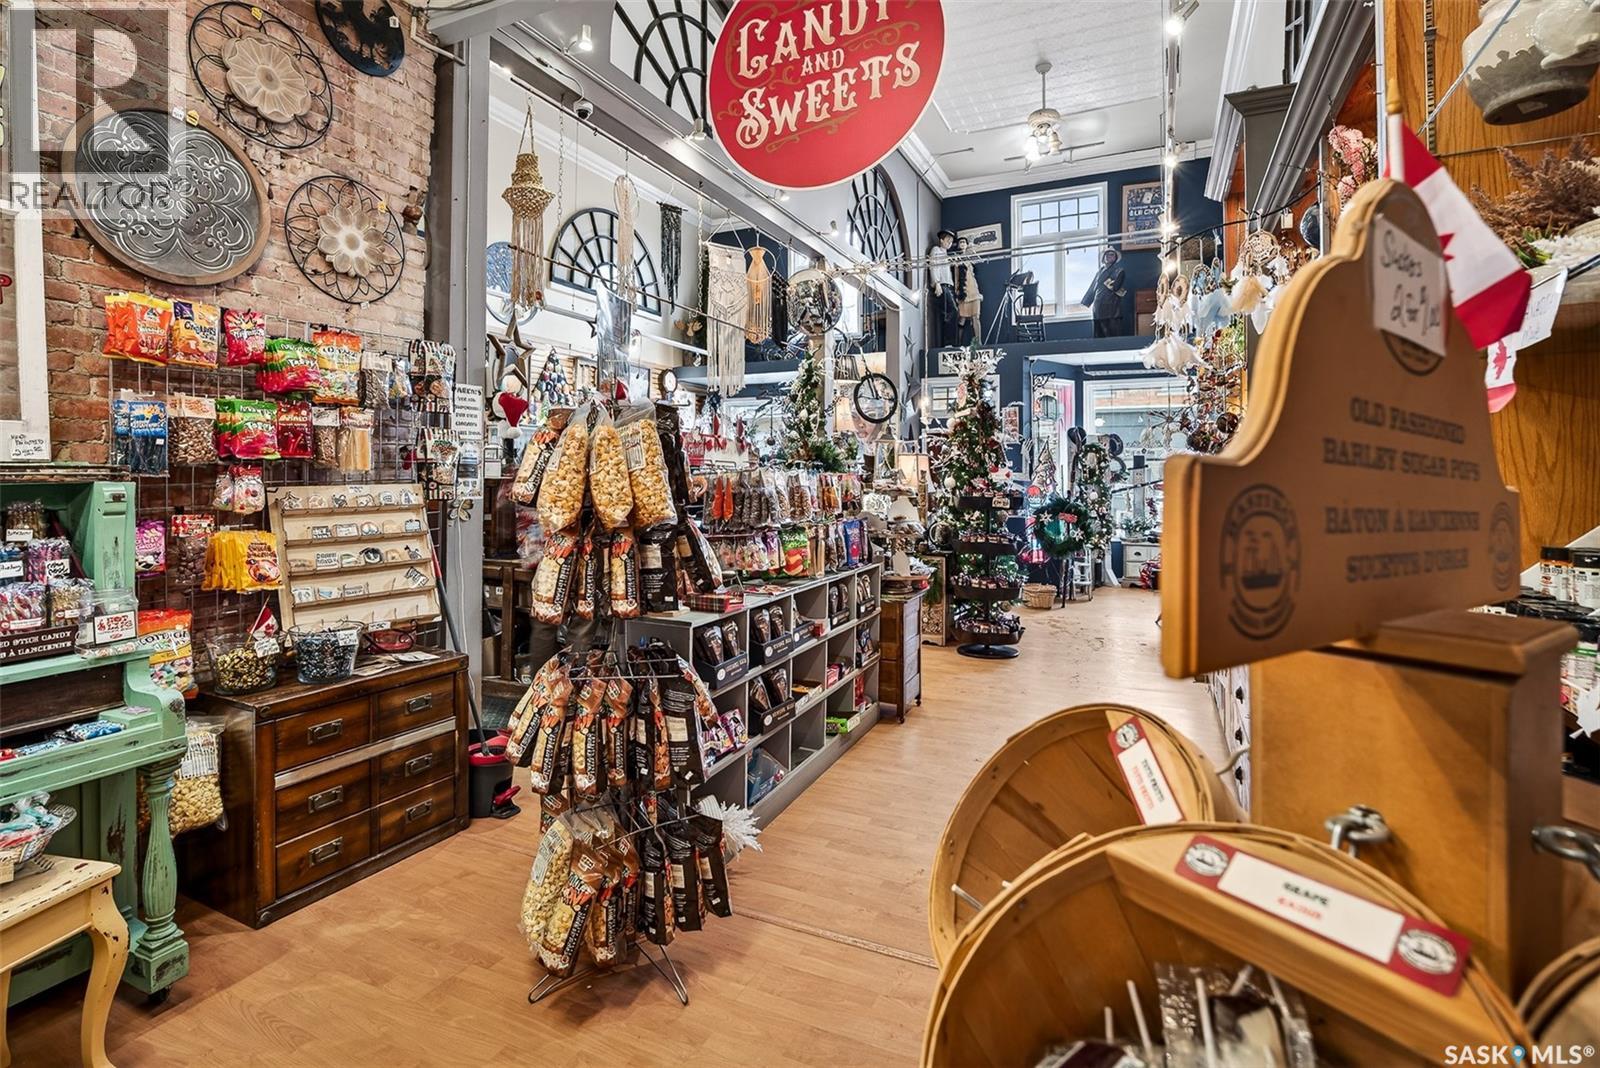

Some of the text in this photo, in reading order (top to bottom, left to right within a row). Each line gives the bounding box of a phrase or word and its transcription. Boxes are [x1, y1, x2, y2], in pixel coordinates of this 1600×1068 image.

[801, 48, 845, 77] AND
[736, 41, 921, 149] SWEETS
[1351, 396, 1465, 445] OLD FASHIONED
[1322, 437, 1480, 482] BARLEY SUGAR POPS
[13, 636, 39, 646] STICK
[41, 630, 72, 641] CANDY
[1283, 882, 1330, 906] GRAPE
